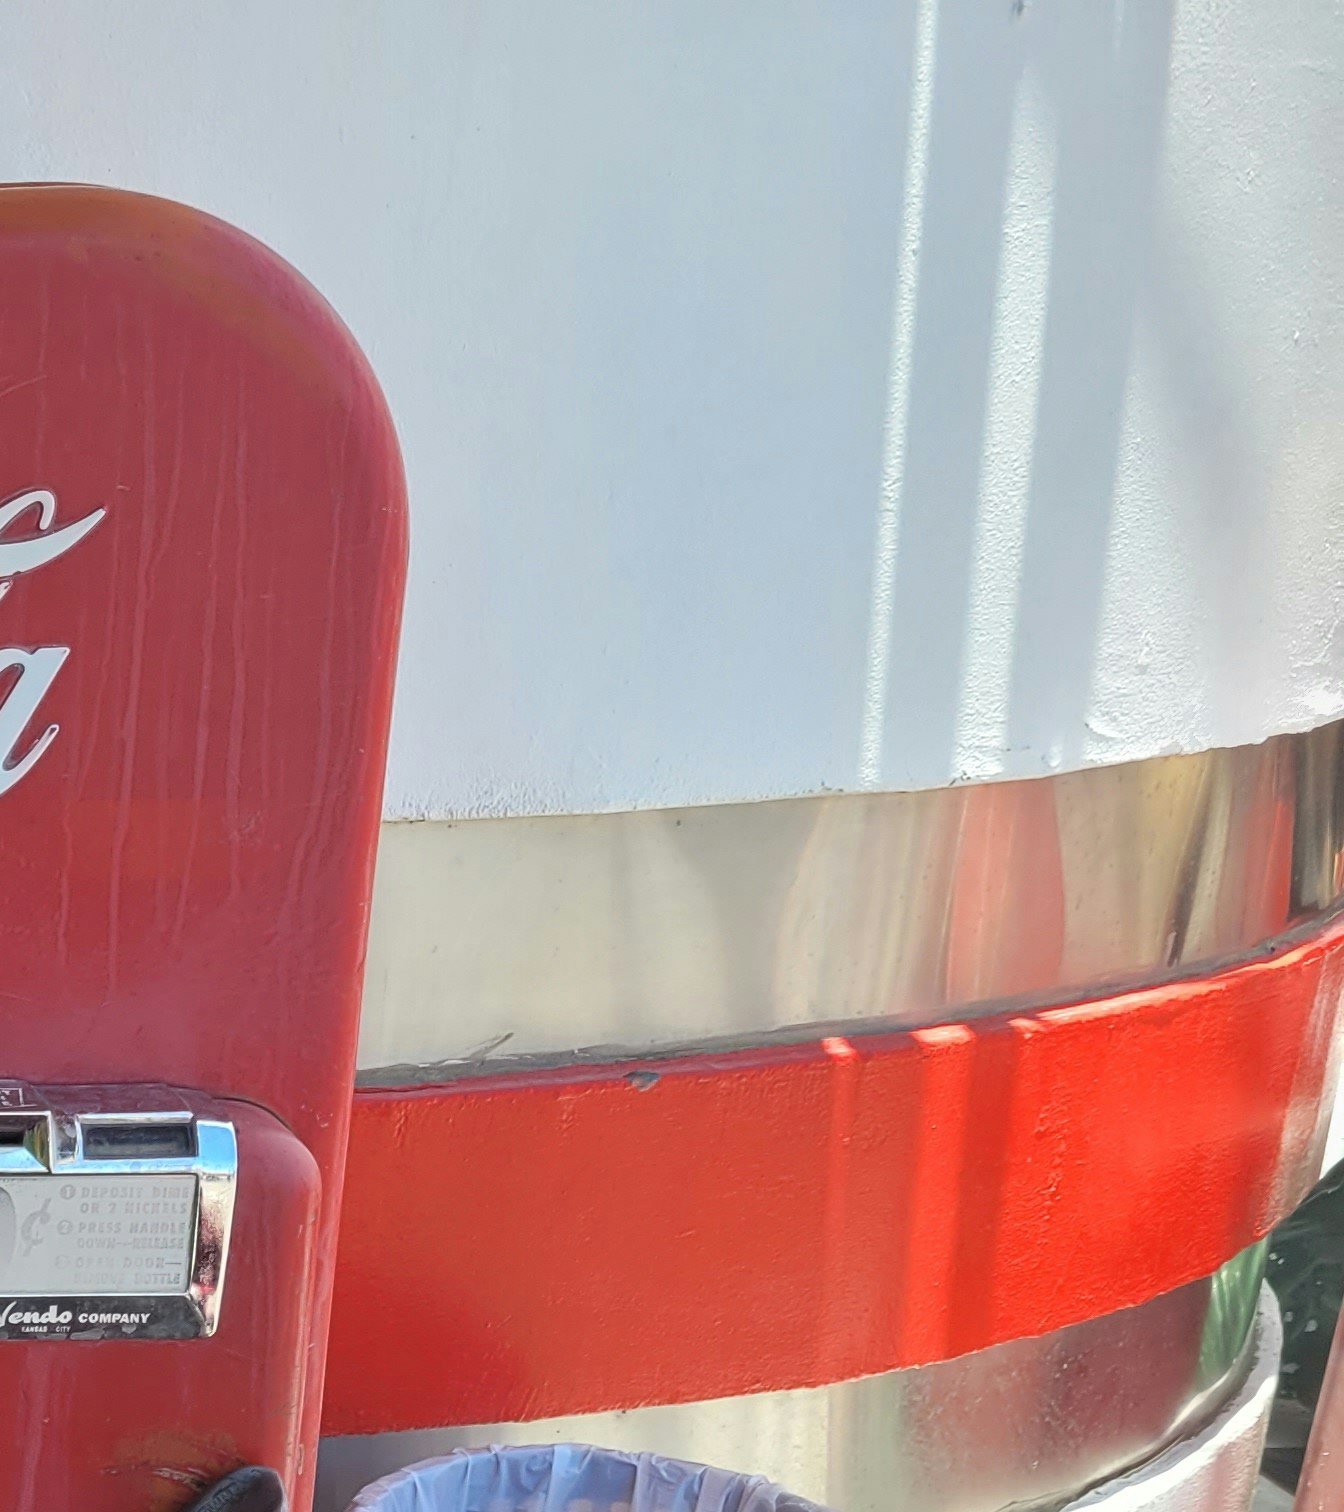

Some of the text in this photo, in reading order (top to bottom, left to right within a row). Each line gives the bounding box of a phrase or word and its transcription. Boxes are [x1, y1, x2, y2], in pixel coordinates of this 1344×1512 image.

[81, 1187, 143, 1198] DEPOSIT
[80, 1202, 100, 1214] OR
[125, 1202, 187, 1214] NICKELS
[78, 1222, 122, 1233] PRESS
[129, 1222, 186, 1233] HANDLE
[77, 1312, 151, 1324] COMPANY
